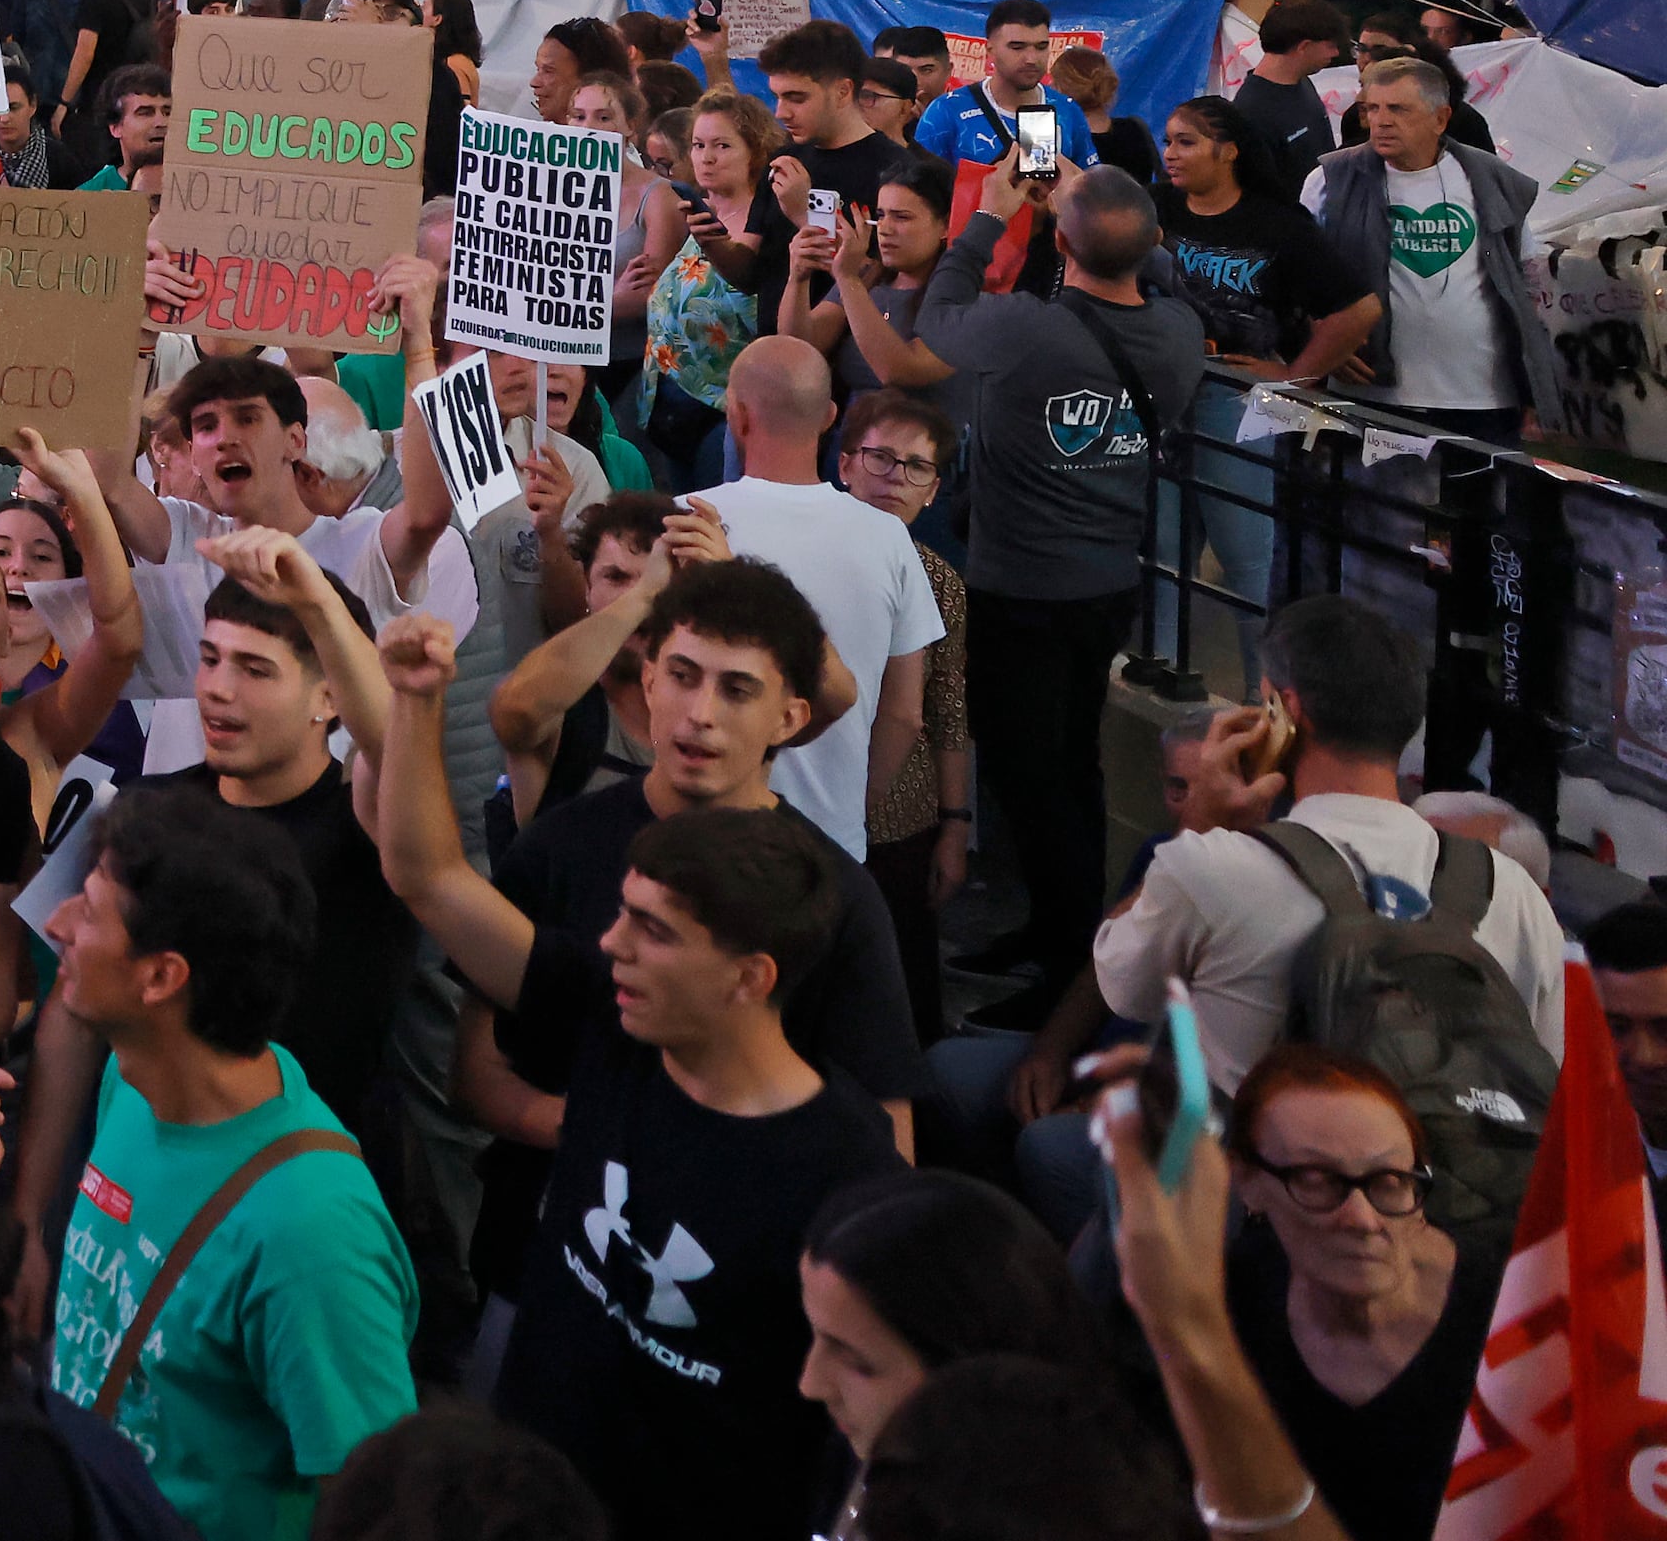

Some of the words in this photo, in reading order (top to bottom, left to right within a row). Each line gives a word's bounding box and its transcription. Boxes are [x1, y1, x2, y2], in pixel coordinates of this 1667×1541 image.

[198, 33, 283, 93] Que
[299, 56, 389, 100] ser
[186, 107, 417, 170] EDUCADOS
[462, 116, 621, 173] EDUCACIÓN
[170, 172, 210, 211] NO
[216, 175, 380, 226] IMPLIQUE
[459, 150, 613, 212] PÚBLICA
[457, 191, 485, 222] DE
[496, 200, 613, 245] CALIDAD
[1394, 219, 1461, 234] ANIDAD
[454, 222, 611, 275] ANTIRRACISTA
[454, 249, 605, 303] FEMINISTA
[451, 318, 500, 341] IZQUIERDA
[453, 280, 509, 317] PARA
[525, 296, 605, 330] TODAS
[1062, 399, 1100, 426] WD
